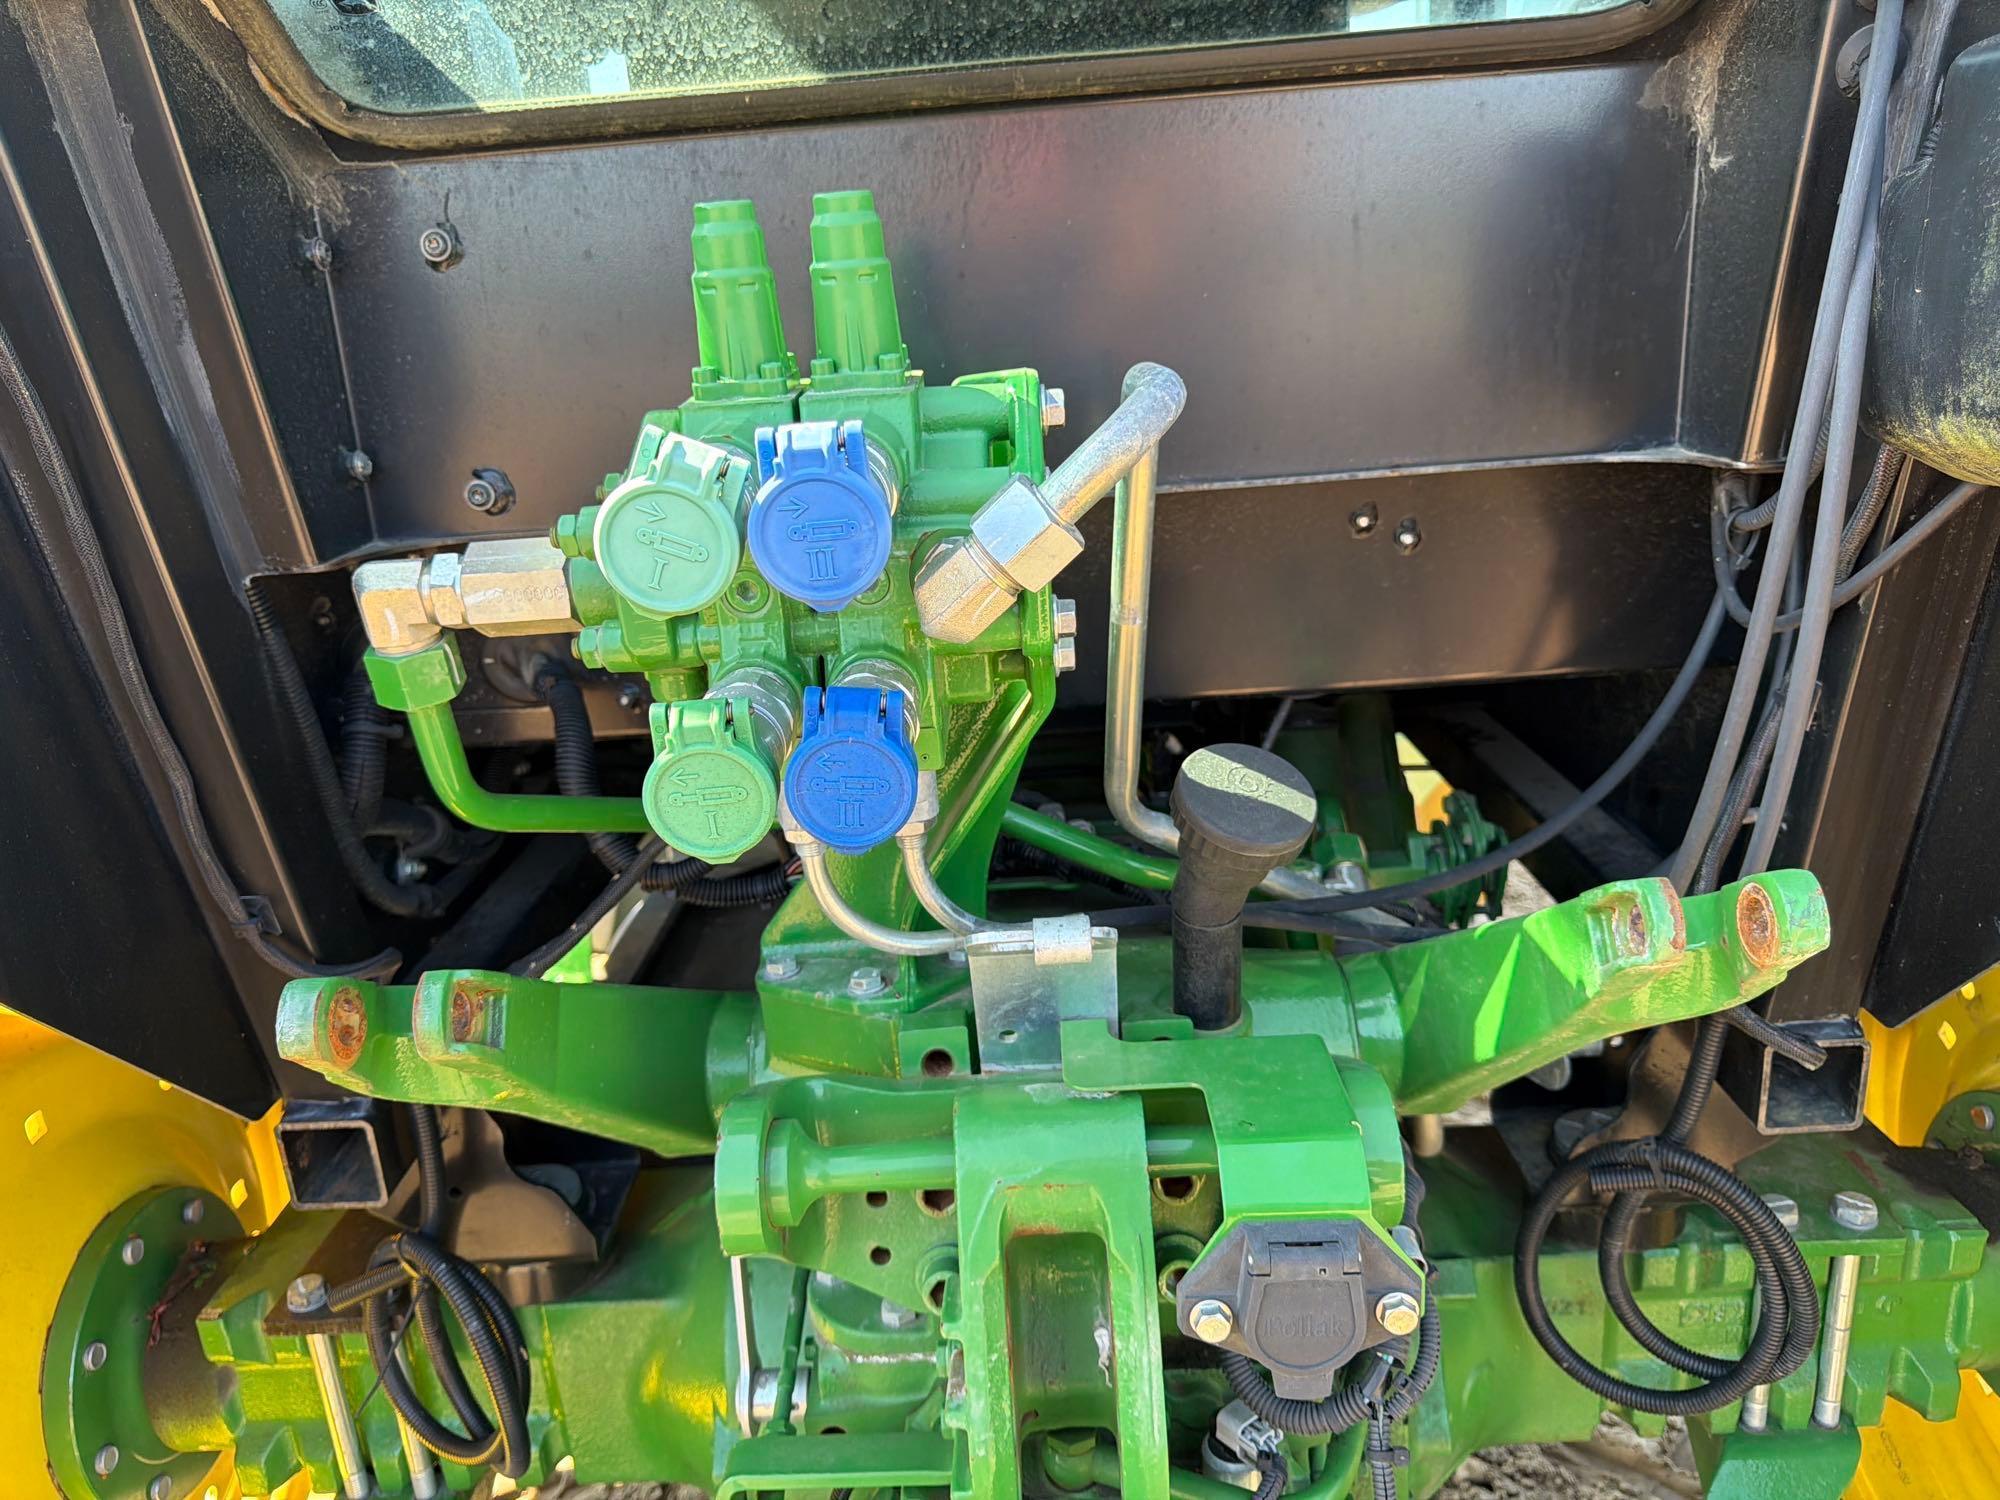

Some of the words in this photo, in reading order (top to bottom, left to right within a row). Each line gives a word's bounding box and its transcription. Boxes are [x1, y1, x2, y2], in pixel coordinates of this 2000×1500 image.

[648, 557, 669, 591] I
[805, 548, 839, 581] II
[704, 810, 721, 840] I
[836, 799, 865, 829] II
[1264, 1312, 1344, 1337] Pollak
